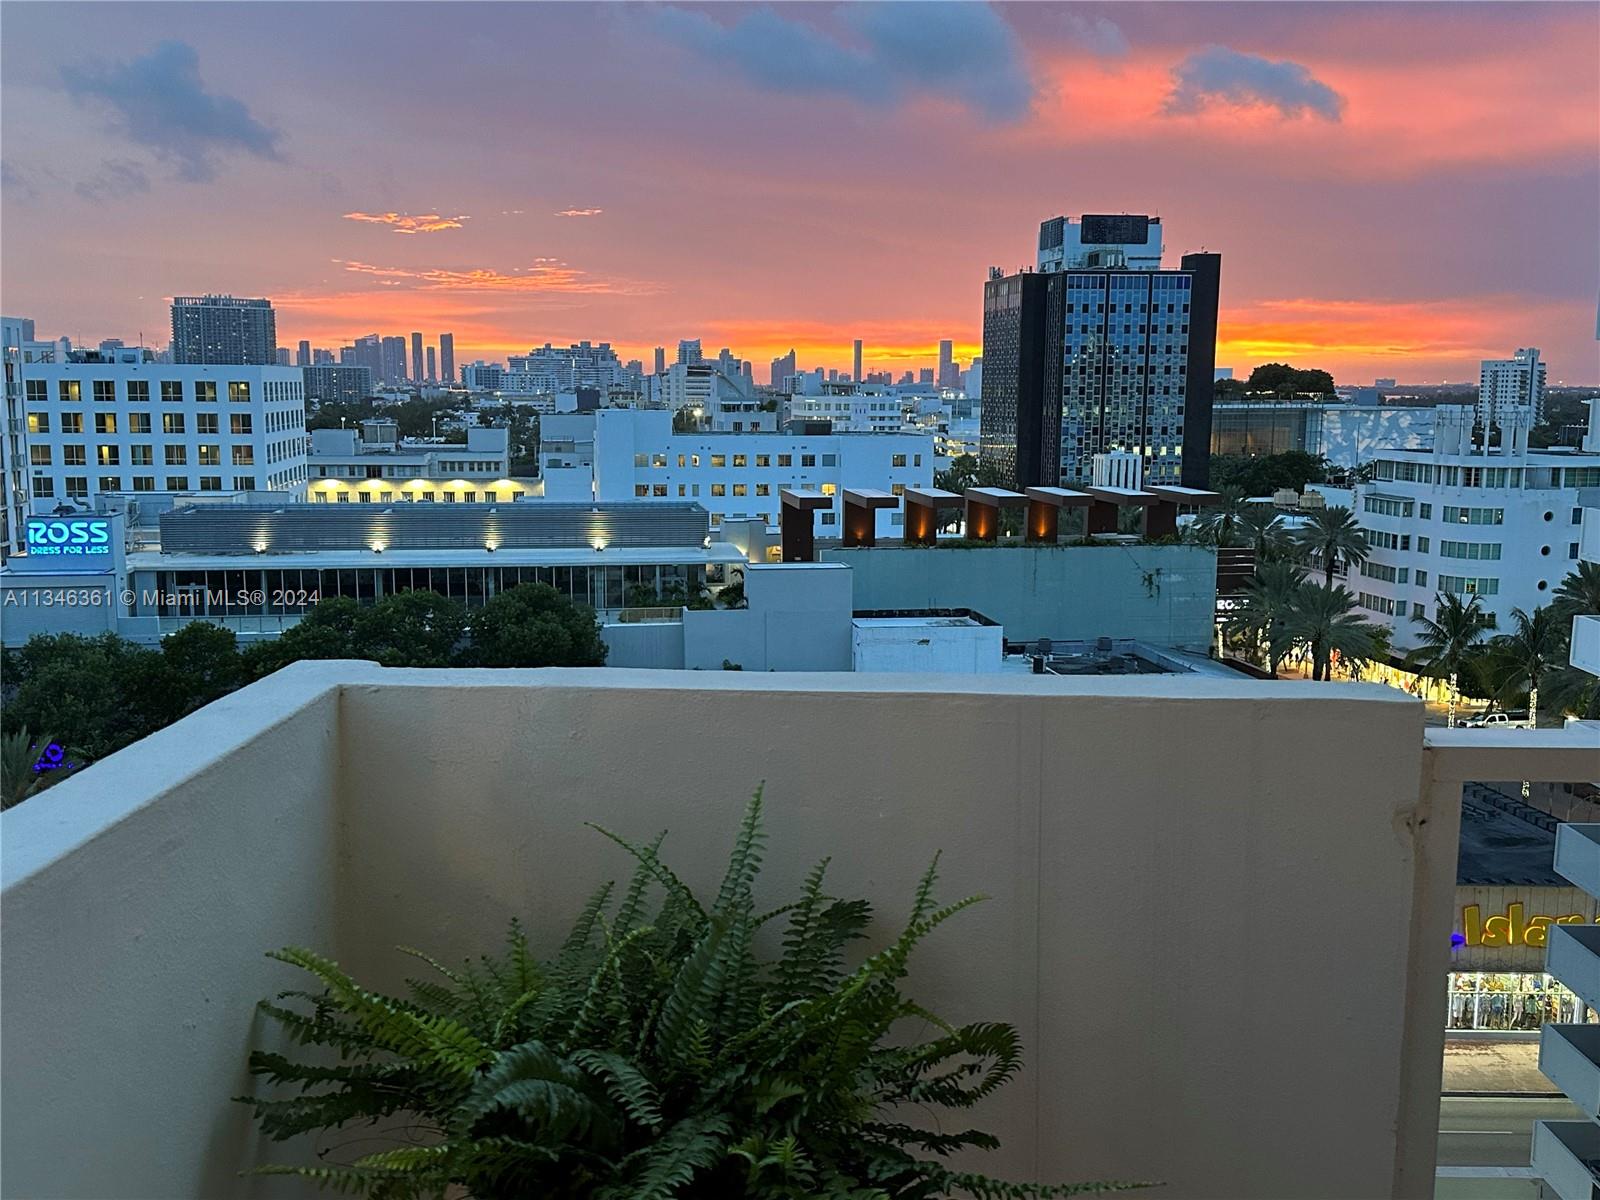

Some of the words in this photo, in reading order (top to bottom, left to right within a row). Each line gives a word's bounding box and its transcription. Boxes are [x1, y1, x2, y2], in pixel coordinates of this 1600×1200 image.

[28, 523, 108, 544] ROSS
[31, 546, 61, 554] DRESS
[64, 546, 82, 554] FOR
[86, 546, 109, 554] LESS
[1462, 902, 1600, 949] Isla
